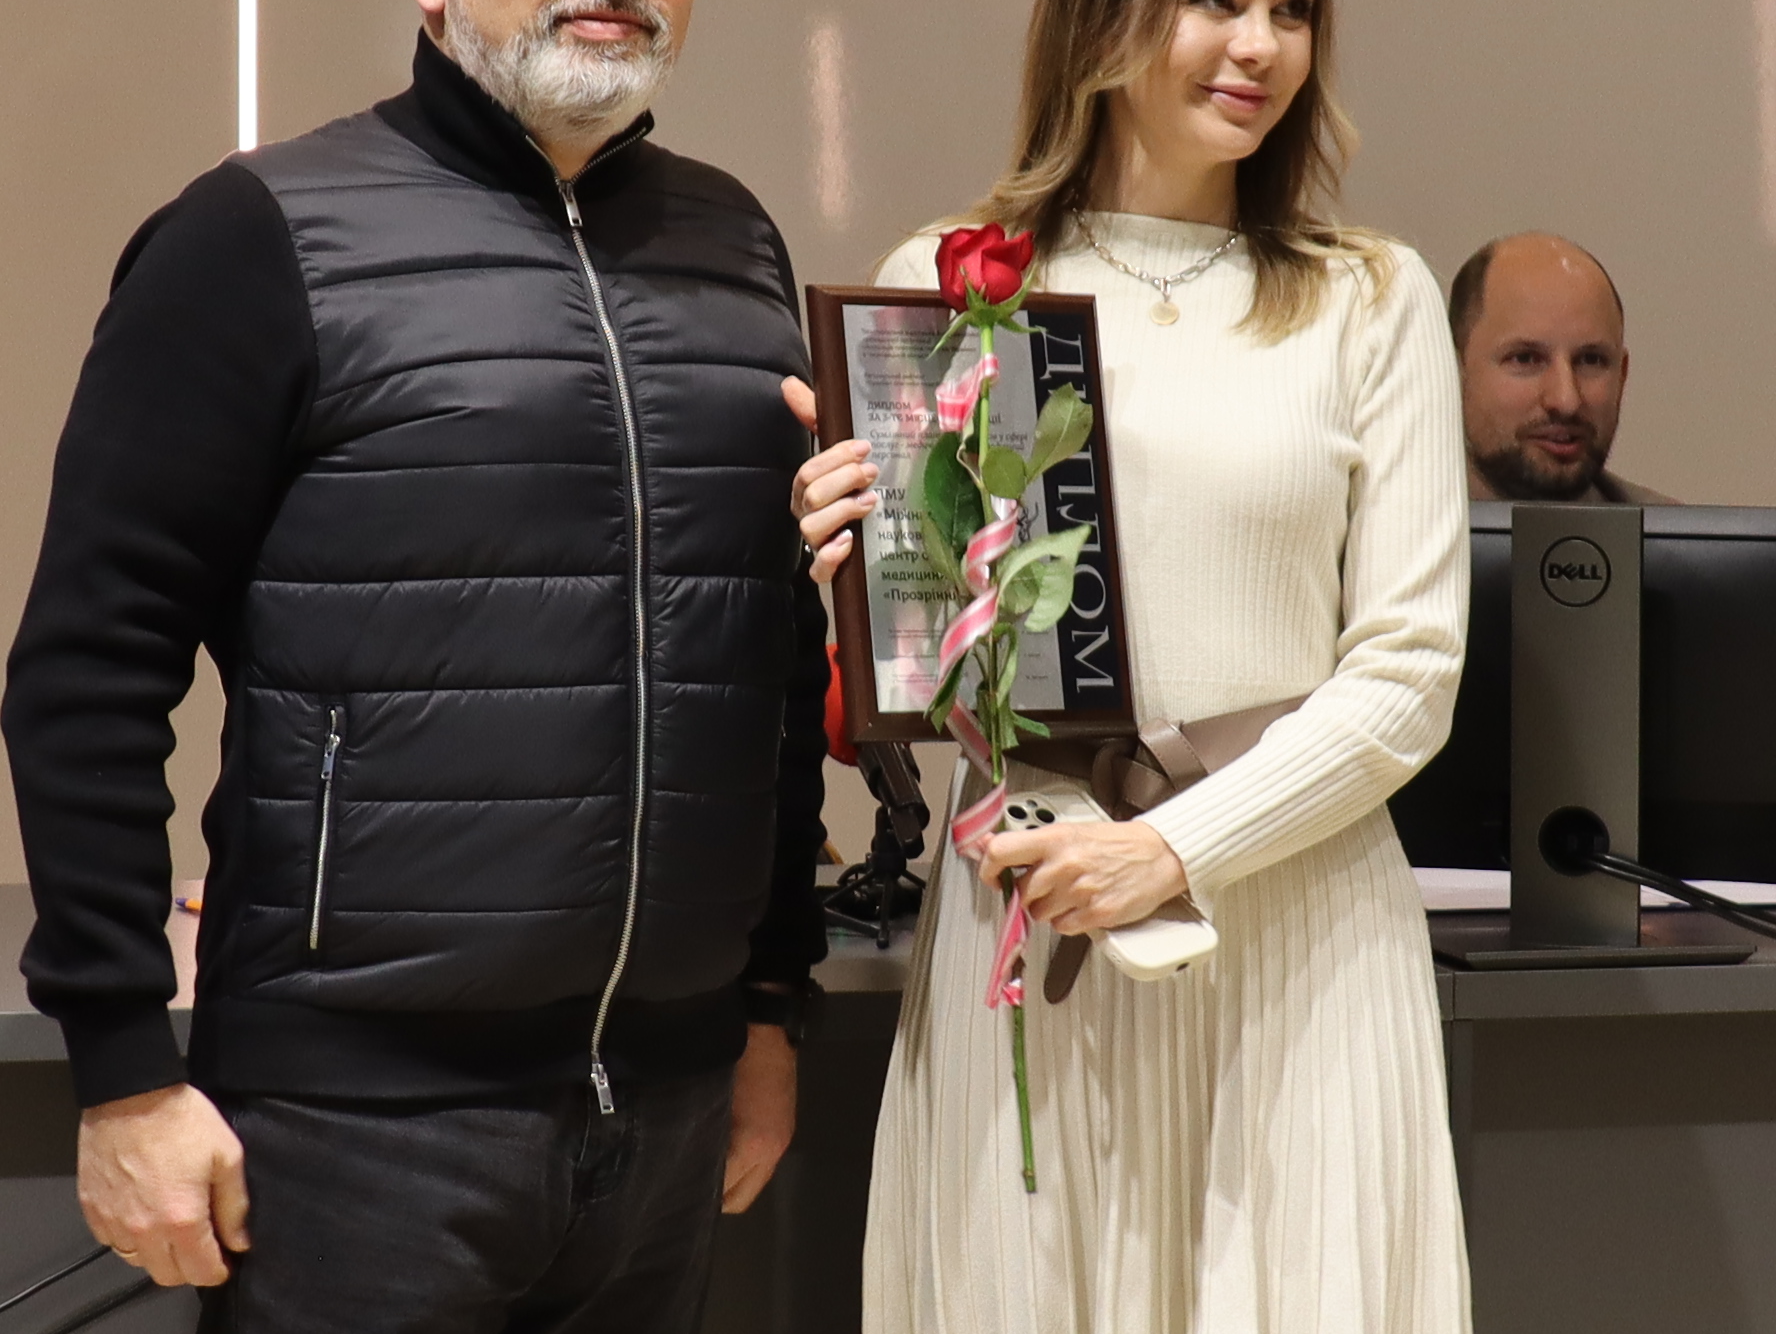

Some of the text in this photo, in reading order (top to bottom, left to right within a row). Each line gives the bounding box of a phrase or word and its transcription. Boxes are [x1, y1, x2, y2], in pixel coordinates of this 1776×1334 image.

[1034, 324, 1115, 694] ДПЛОМ
[877, 528, 923, 543] науков
[1548, 562, 1603, 581] DELL
